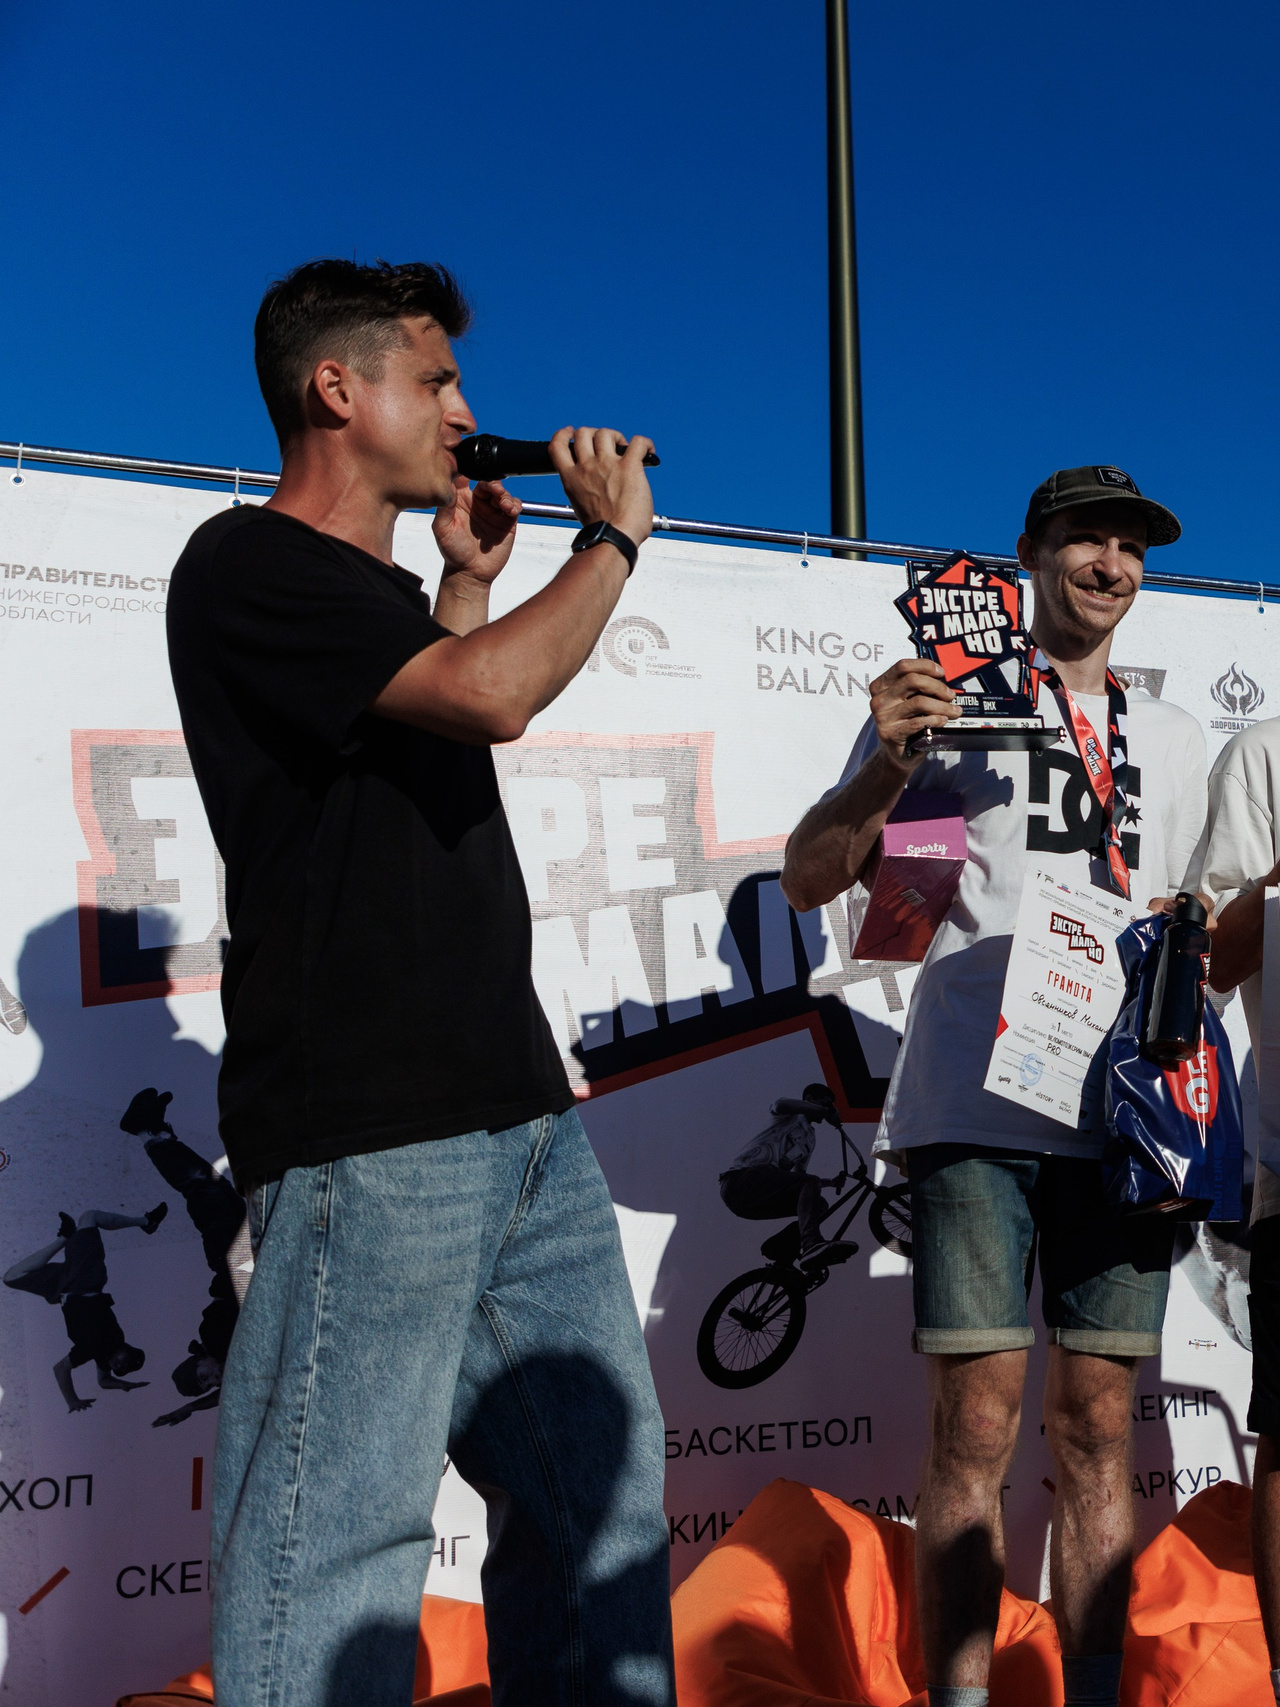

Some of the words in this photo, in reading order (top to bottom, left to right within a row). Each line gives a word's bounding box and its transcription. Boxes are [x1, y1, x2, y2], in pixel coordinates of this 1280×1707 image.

[0, 563, 170, 593] ПРАВИТЕЛЬСТ
[0, 587, 167, 614] ИЖЕГОРОДСКО
[919, 587, 1000, 614] ЭКСТРЕ
[942, 610, 1008, 639] МАЛЬ
[755, 625, 846, 659] KING
[851, 641, 885, 663] OF
[964, 629, 1004, 654] НО
[756, 663, 871, 699] BALĀN
[1210, 720, 1246, 731] ЗДОРОВАЯ
[906, 842, 949, 856] Sporty
[1052, 915, 1083, 936] ЭКСТРЕ
[1070, 935, 1096, 948] МАЛЬ
[1088, 947, 1102, 962] НО
[1047, 969, 1092, 1004] ГРАМОТА
[1057, 1022, 1061, 1033] 1
[1046, 1042, 1062, 1056] PRO
[0, 1474, 93, 1513] ХОП
[1132, 1465, 1223, 1500] АРКУР
